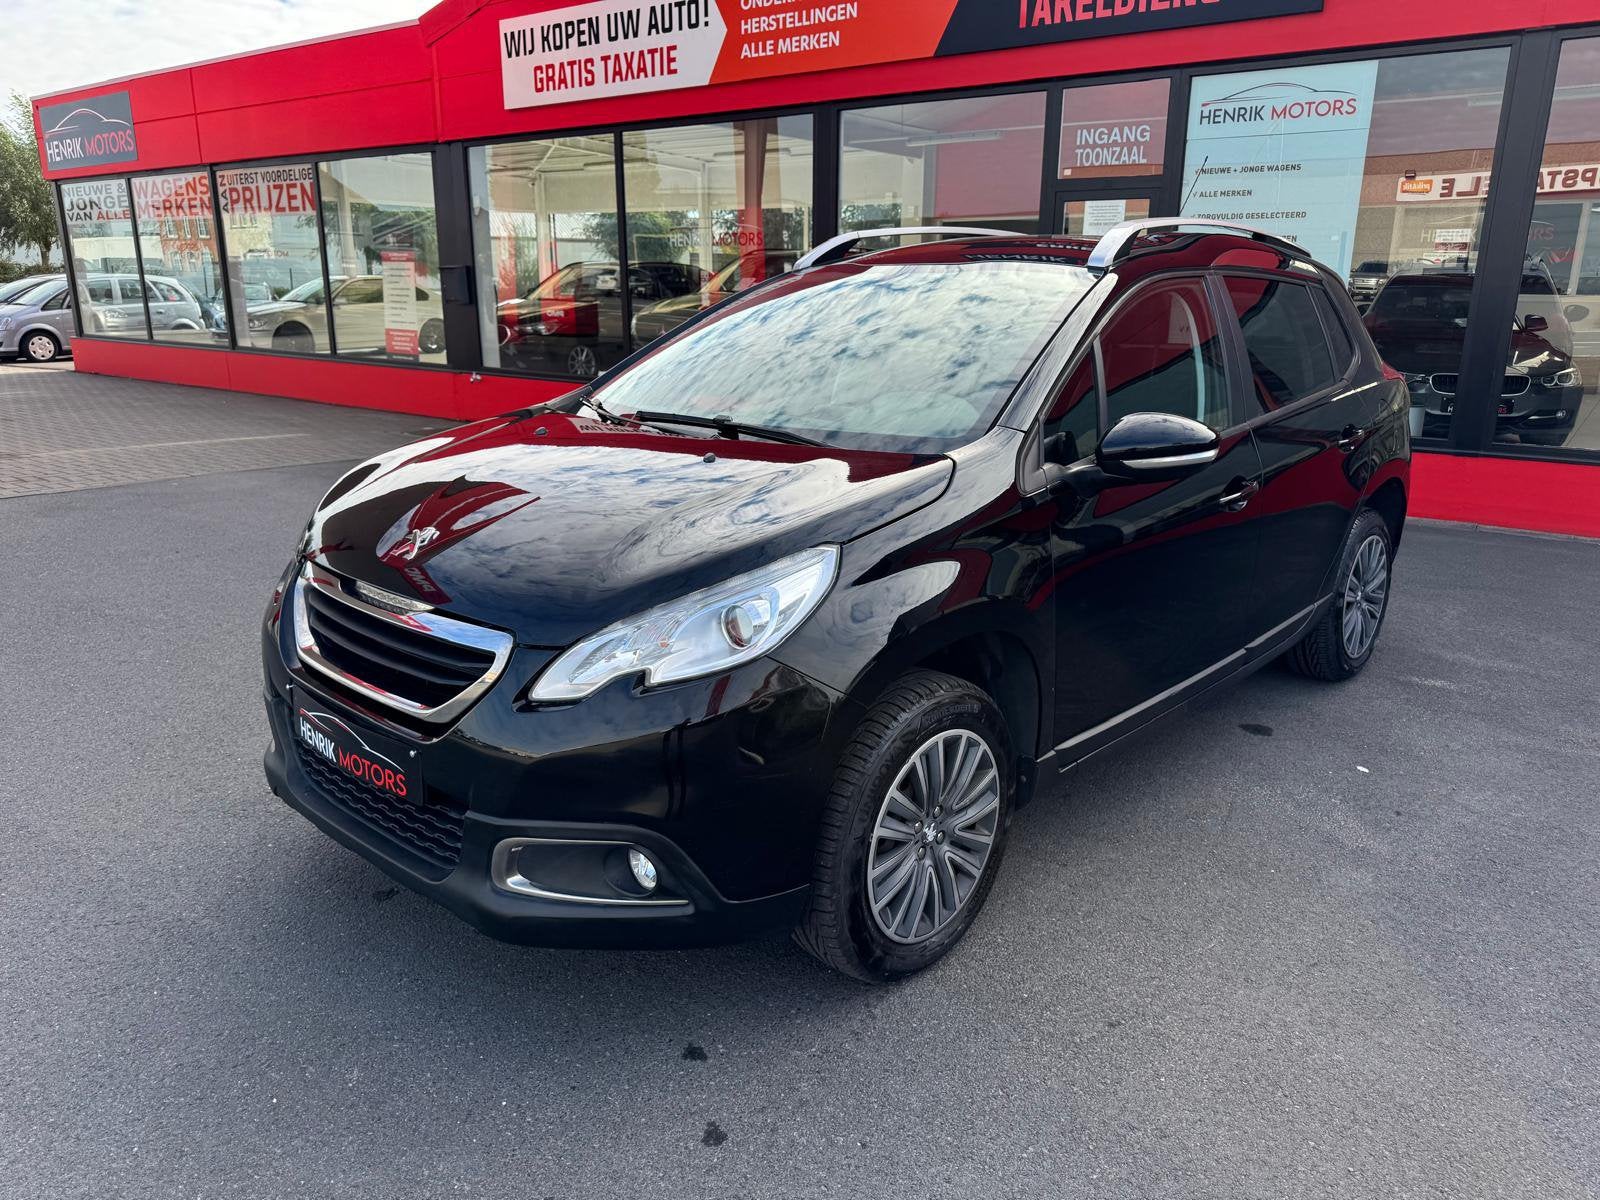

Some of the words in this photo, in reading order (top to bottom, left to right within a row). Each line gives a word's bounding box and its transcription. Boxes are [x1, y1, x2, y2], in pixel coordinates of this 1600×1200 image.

[740, 2, 858, 35] HERSTELLINGEN
[503, 27, 535, 59] WIJ
[541, 16, 601, 53] KOPEN
[607, 8, 641, 42] UW
[647, 0, 710, 36] AUTO!
[740, 40, 775, 59] ALLE
[777, 30, 841, 54] MERKEN
[533, 57, 595, 93] GRATIS
[600, 45, 678, 84] TAXATIE
[1200, 105, 1265, 125] HENRIK
[1271, 98, 1357, 121] MOTORS
[1076, 124, 1151, 145] INGANG
[46, 137, 85, 163] HENRIK
[85, 129, 135, 156] MOTORS
[1075, 145, 1148, 166] TOONZAAL
[261, 167, 313, 183] VOORDELIGE
[1201, 166, 1232, 175] NIEUWE
[1240, 165, 1265, 174] JONGE
[1267, 163, 1302, 172] WAGENS
[63, 183, 113, 198] NIEUWE
[116, 183, 126, 194] &
[133, 174, 210, 200] WAGENS
[228, 181, 316, 214] PRIJZEN
[1199, 190, 1218, 198] ALLE
[1220, 189, 1253, 197] MERKEN
[66, 195, 130, 212] JONGE
[137, 197, 212, 218] MERKEN
[67, 212, 93, 221] VAN
[97, 209, 131, 220] ALLE
[1197, 212, 1244, 220] ZORGVULDIG
[1245, 211, 1307, 219] GESELECTEERD
[711, 231, 763, 247] MOTORS
[300, 716, 337, 763] HENRIK
[338, 746, 408, 797] MOTORS
